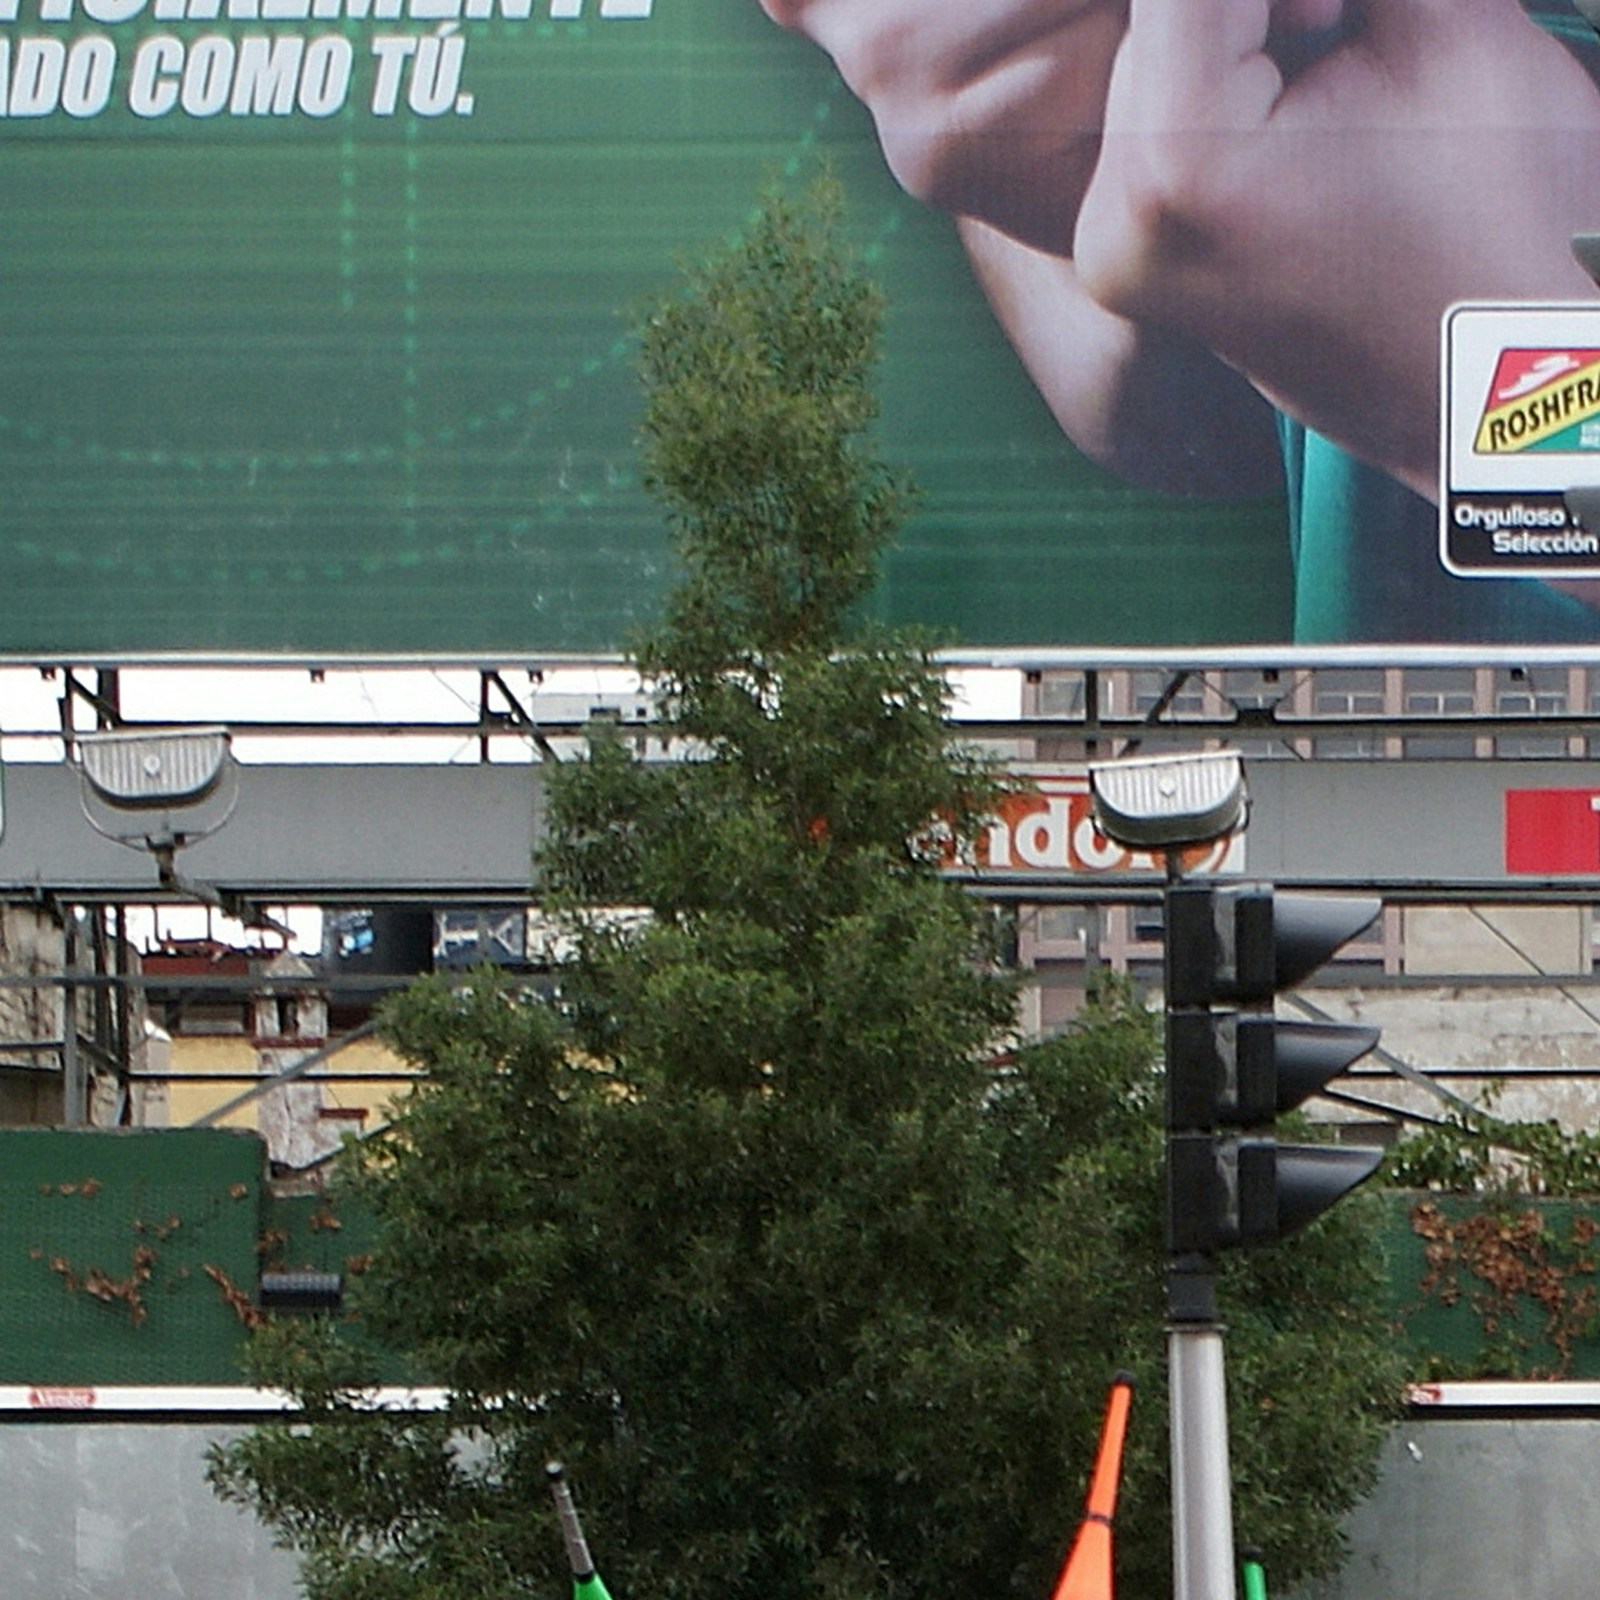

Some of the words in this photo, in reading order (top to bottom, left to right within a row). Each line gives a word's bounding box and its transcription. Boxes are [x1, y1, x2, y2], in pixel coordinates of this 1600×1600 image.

[0, 35, 117, 118] DO
[129, 34, 353, 118] COMO
[372, 21, 474, 117] TÚ.
[1454, 503, 1566, 530] Orgulloso
[1493, 531, 1599, 553] Selección
